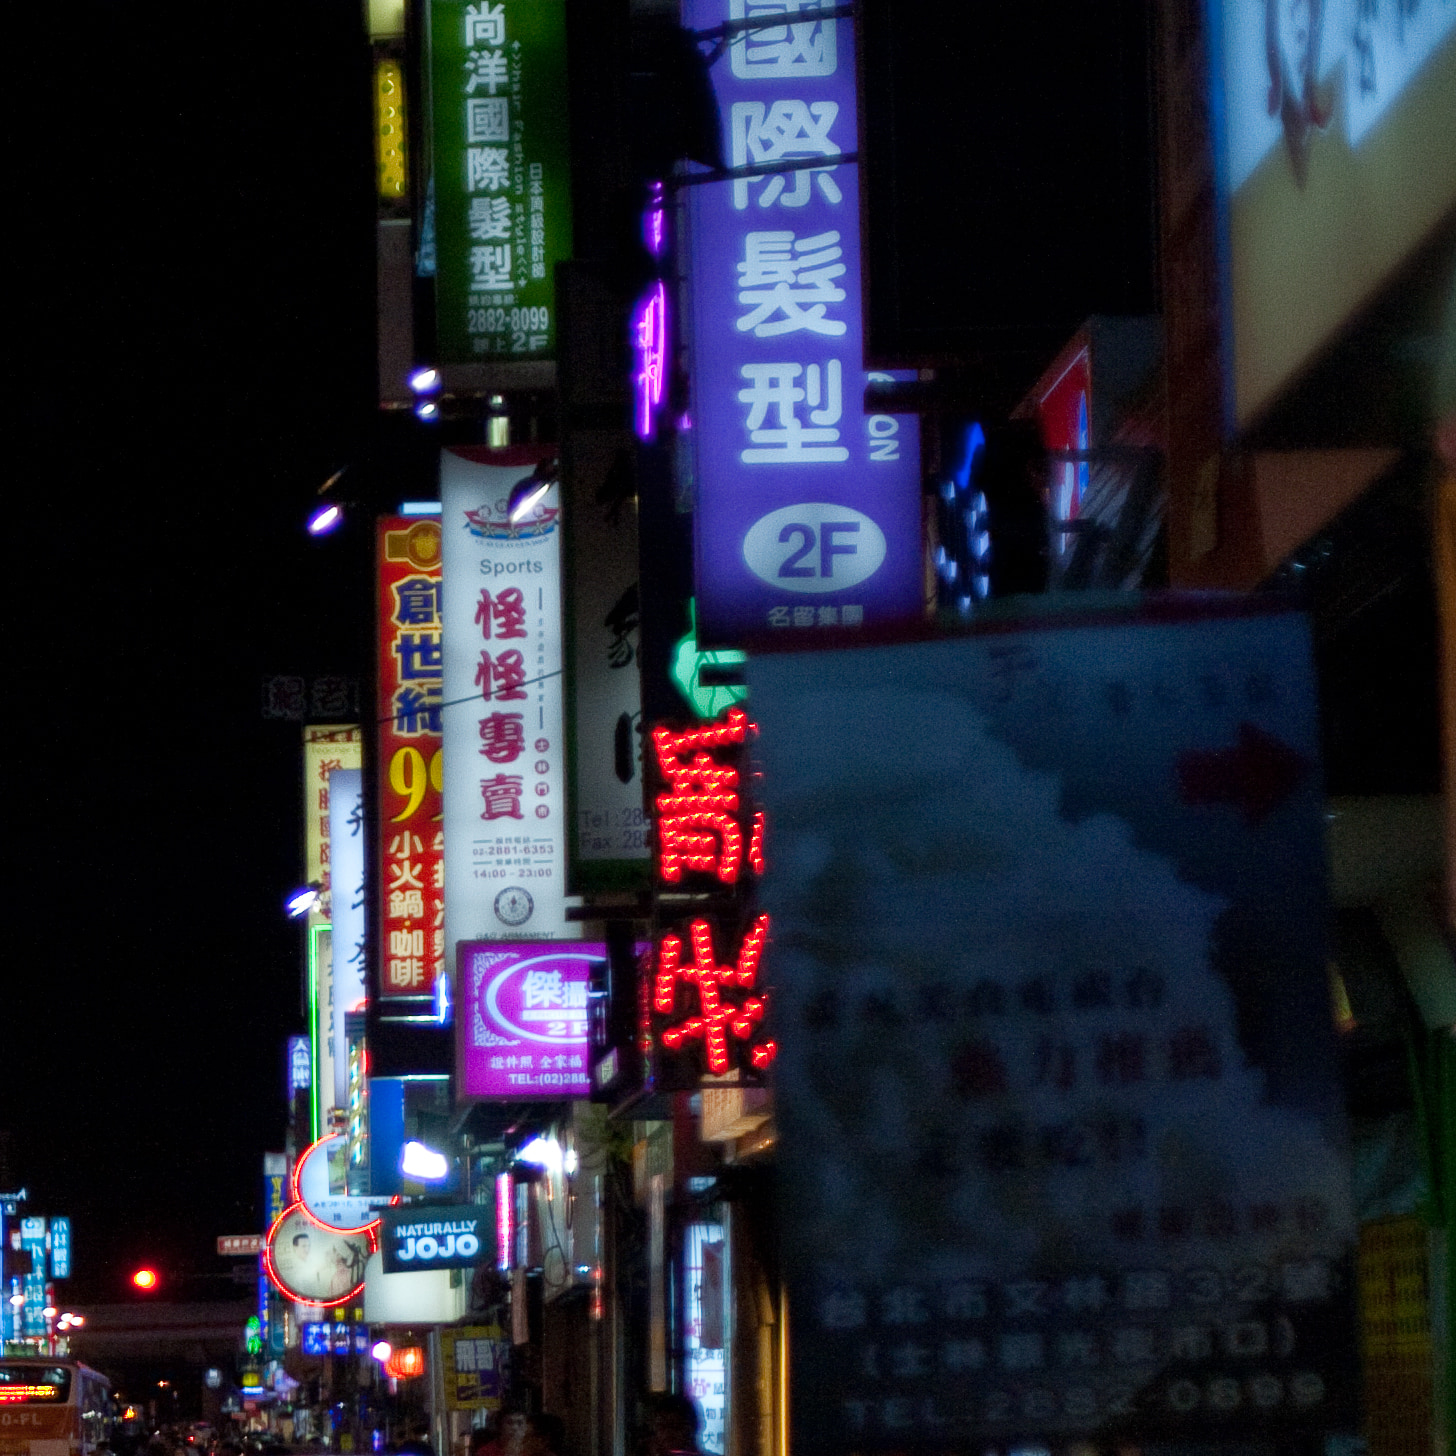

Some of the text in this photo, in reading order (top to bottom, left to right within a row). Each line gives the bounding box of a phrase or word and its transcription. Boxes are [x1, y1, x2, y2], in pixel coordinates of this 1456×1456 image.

[464, 0, 515, 291] 尚洋國際髮型
[467, 306, 549, 333] 2882-8099
[777, 521, 861, 579] 2F
[479, 558, 544, 578] Sports
[474, 586, 529, 821] 怪怪專賣
[396, 1218, 478, 1238] NATURALLY
[397, 1233, 479, 1261] JOJO
